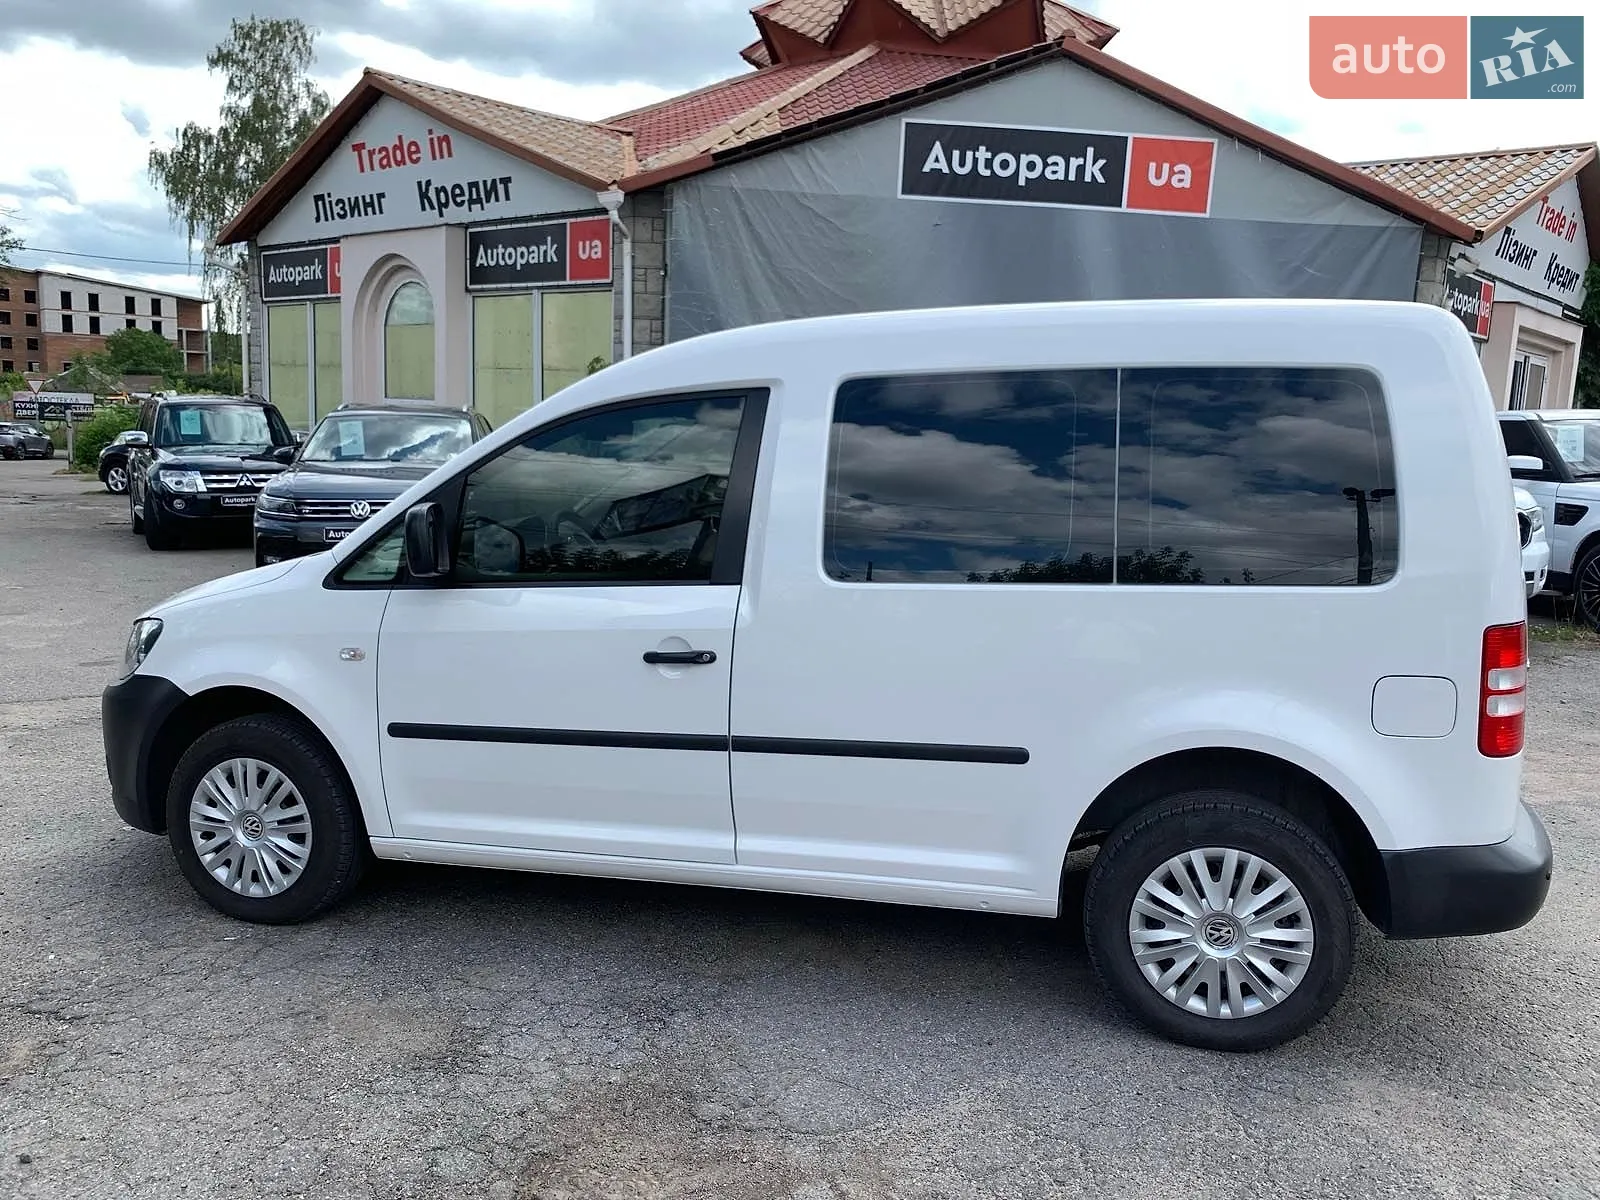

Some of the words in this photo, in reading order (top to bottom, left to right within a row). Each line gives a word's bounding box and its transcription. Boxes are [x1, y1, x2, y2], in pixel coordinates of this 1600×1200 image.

[352, 135, 421, 173] Trade
[428, 129, 453, 161] in
[921, 140, 1107, 186] Autopark
[1147, 160, 1192, 189] ua
[313, 192, 386, 223] Лізинг
[416, 176, 512, 218] Кредит
[1536, 196, 1566, 236] Trade
[1564, 212, 1578, 243] in
[268, 259, 323, 285] Autopark
[475, 236, 558, 271] Autopark
[578, 237, 602, 260] ua
[1495, 226, 1538, 271] Лізинг
[1544, 252, 1580, 293] Кредит
[224, 496, 257, 504] Autopark
